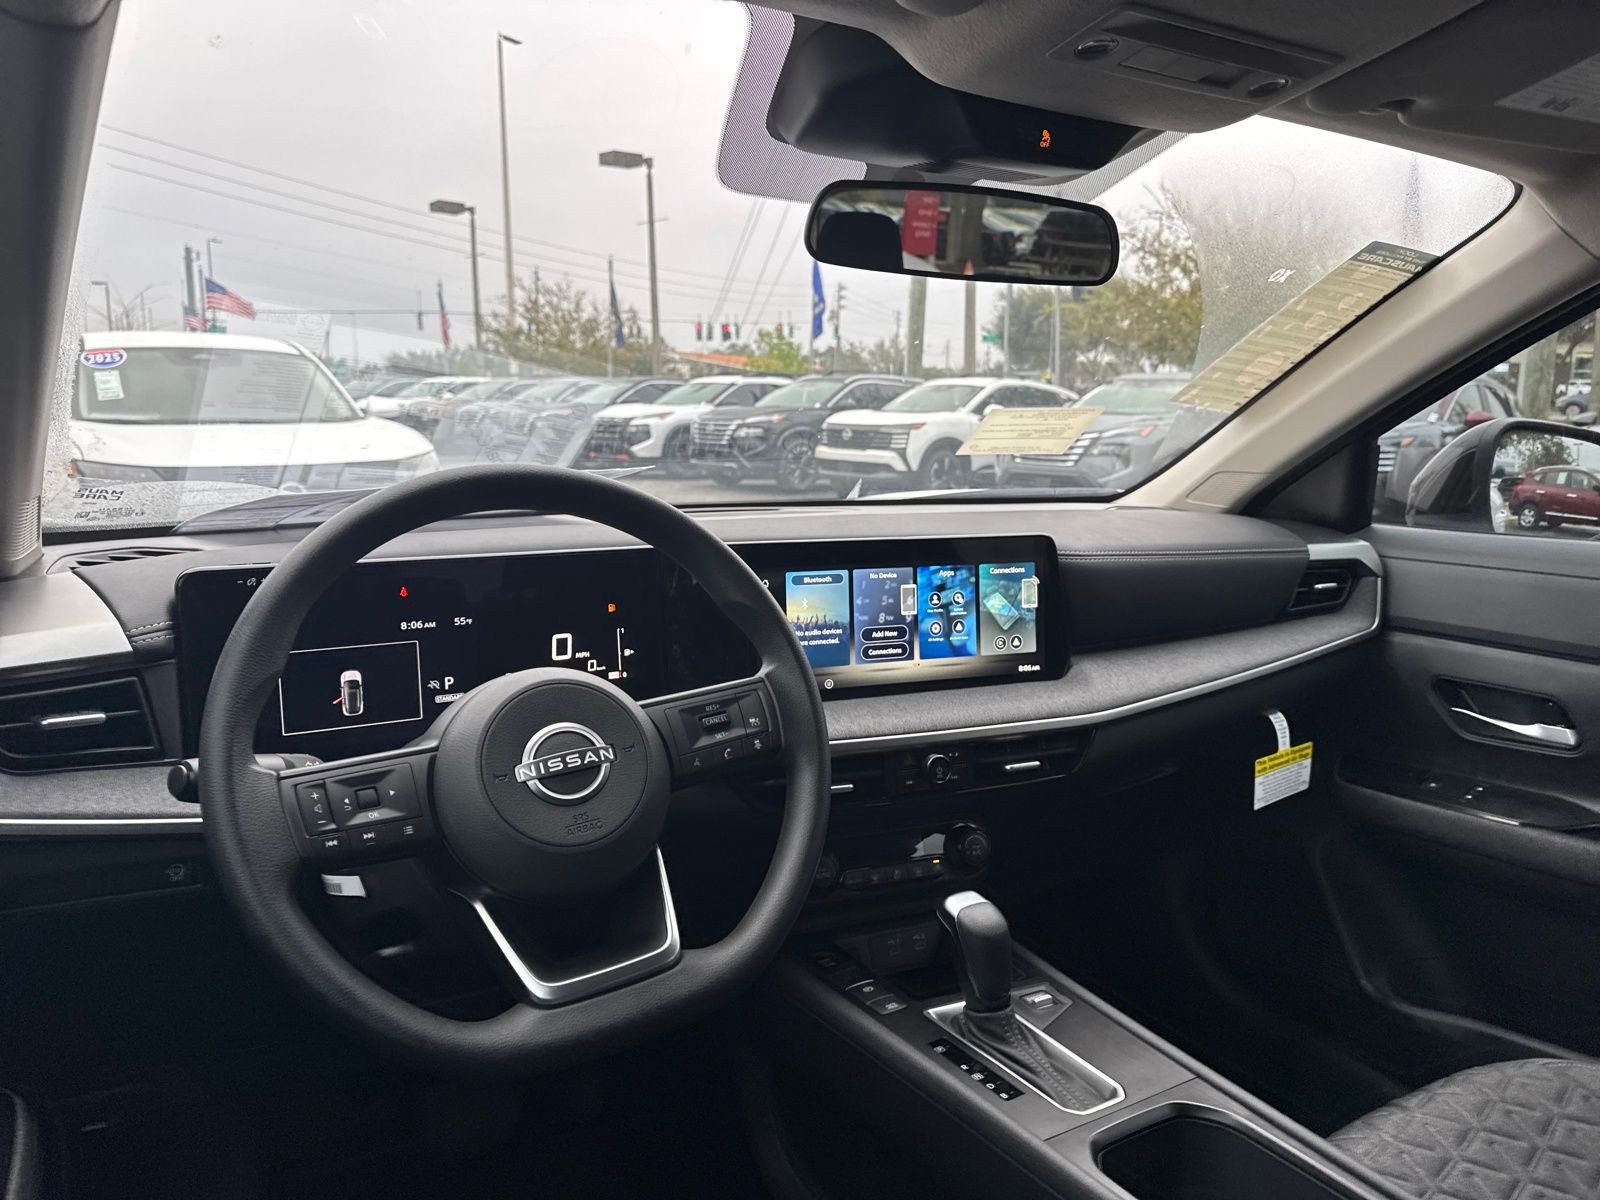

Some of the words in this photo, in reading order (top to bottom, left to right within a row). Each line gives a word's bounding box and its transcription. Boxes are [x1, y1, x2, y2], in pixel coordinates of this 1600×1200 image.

[939, 569, 955, 577] Apps
[989, 566, 1026, 574] Connections
[803, 575, 833, 584] Bluetooth
[400, 620, 423, 630] 8:06
[871, 630, 884, 638] Add
[868, 648, 902, 656] Connections
[444, 676, 455, 690] P
[518, 747, 615, 781] NISSAN
[368, 811, 380, 819] OK
[572, 811, 590, 823] SRS
[566, 820, 604, 836] AIRBAG
